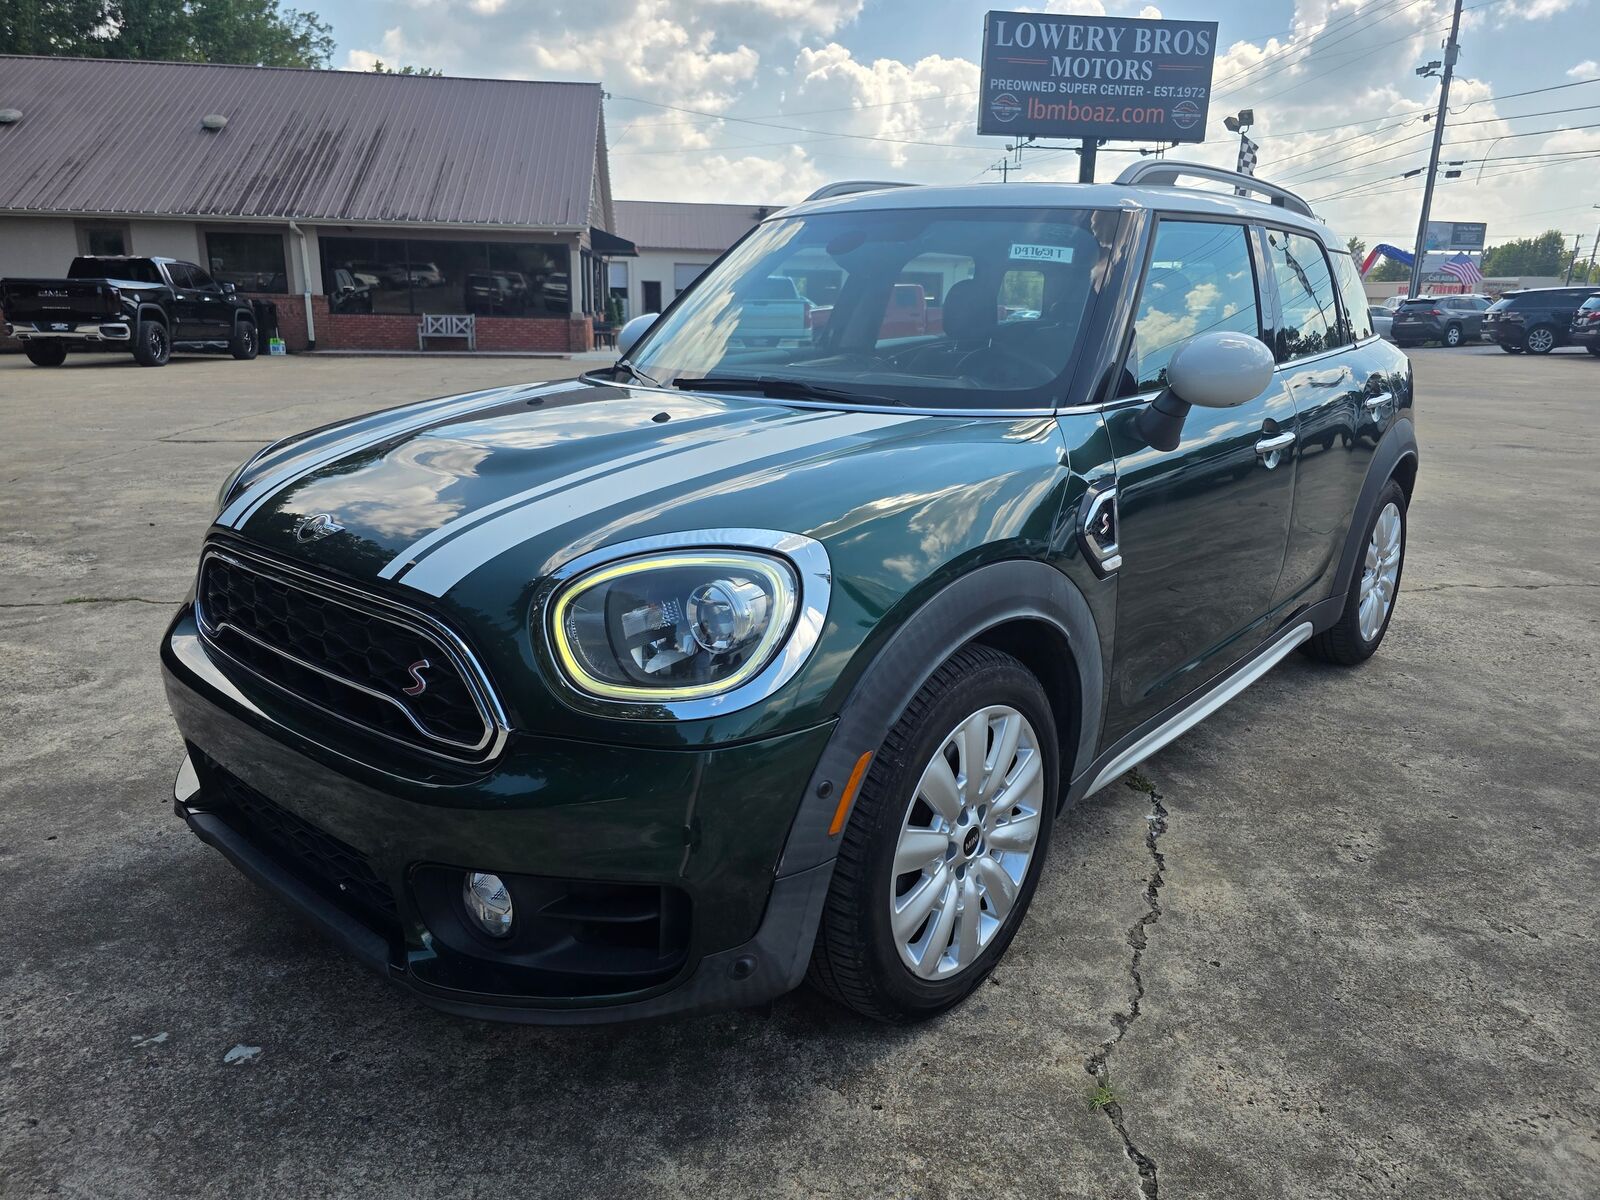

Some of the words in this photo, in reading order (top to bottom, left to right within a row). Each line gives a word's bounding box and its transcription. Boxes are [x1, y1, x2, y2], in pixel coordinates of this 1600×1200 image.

[995, 20, 1127, 53] LOWERY
[1132, 28, 1210, 56] BROS
[1050, 55, 1153, 81] MOTORS
[990, 79, 1056, 93] PREOWNED
[1059, 83, 1097, 95] SUPER
[1100, 84, 1144, 97] CENTER
[1154, 86, 1206, 98] EST.1972
[1027, 96, 1164, 124] lbmboaz.com
[402, 659, 430, 696] S
